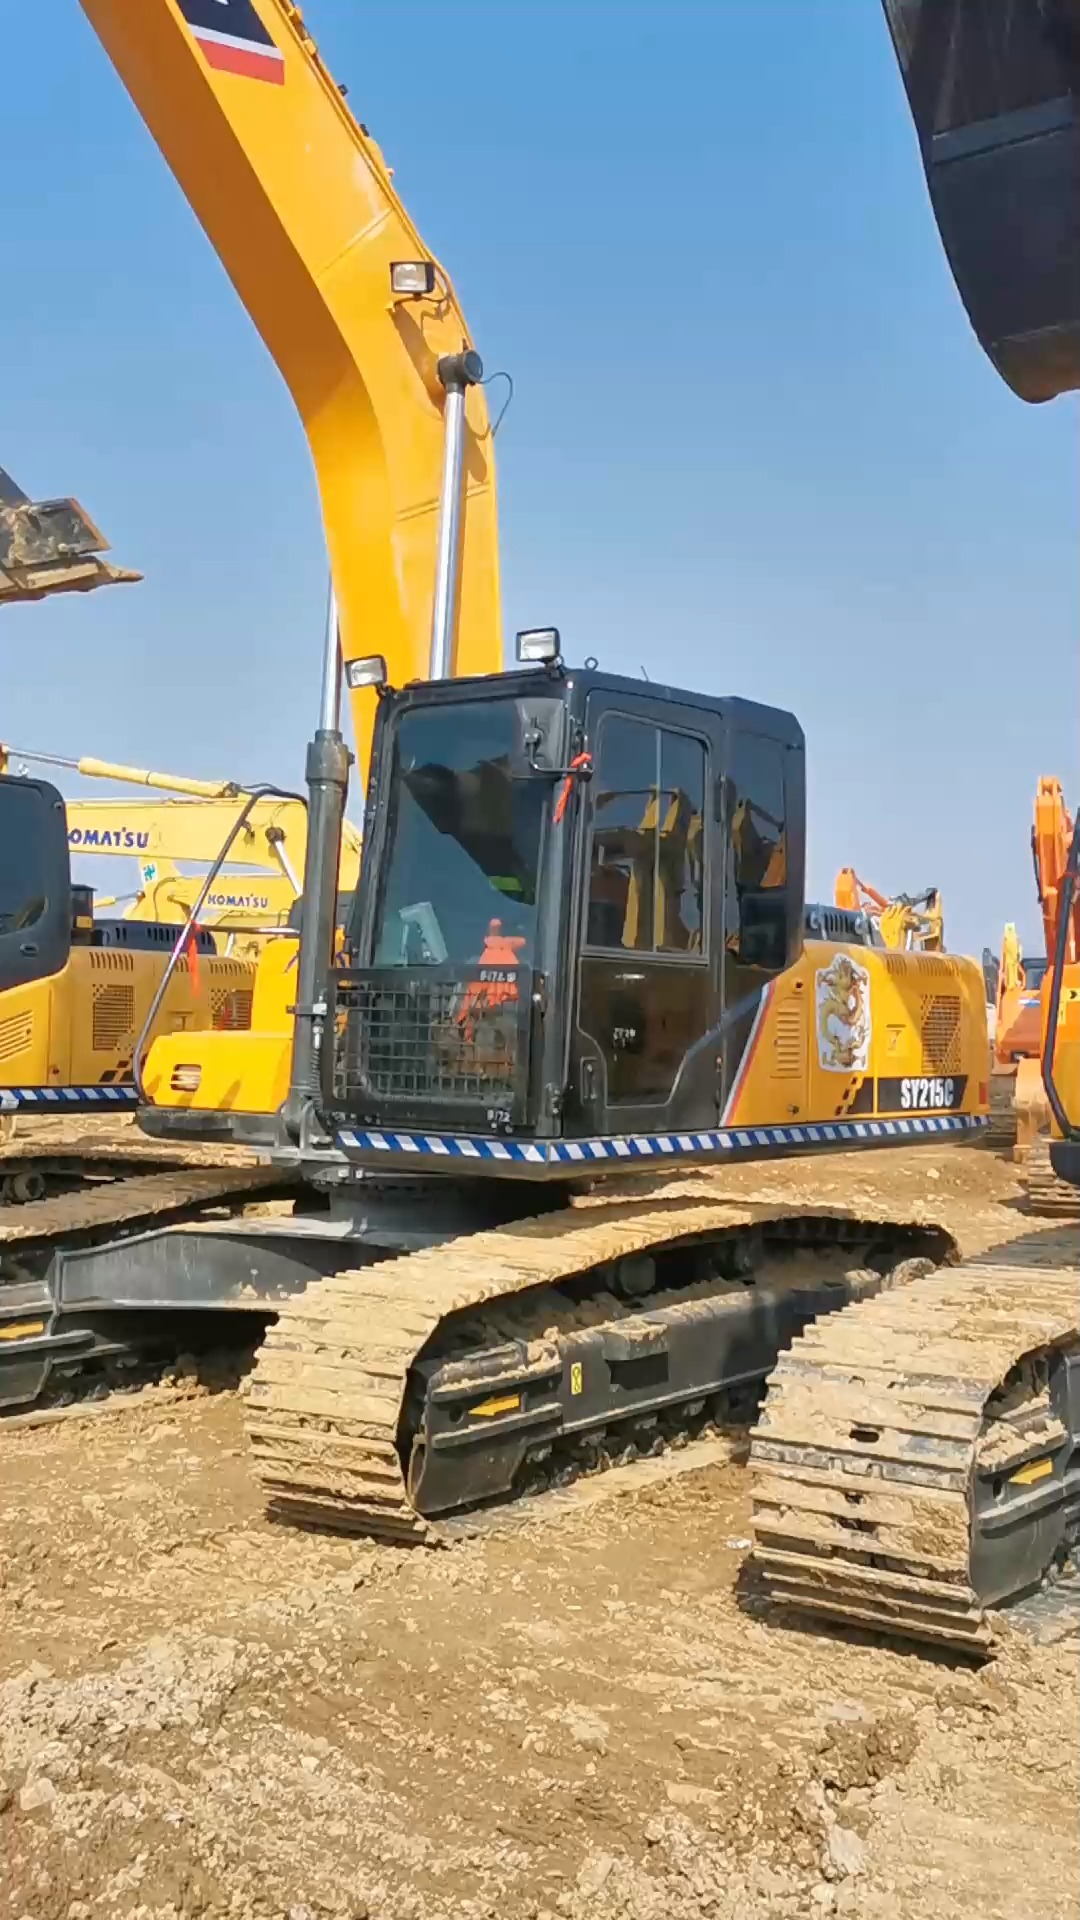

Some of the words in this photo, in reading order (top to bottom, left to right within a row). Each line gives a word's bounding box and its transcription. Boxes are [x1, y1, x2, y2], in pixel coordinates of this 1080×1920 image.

[67, 827, 150, 849] OMATSU
[208, 893, 268, 909] KOMATSU
[900, 1077, 954, 1109] SY215C
